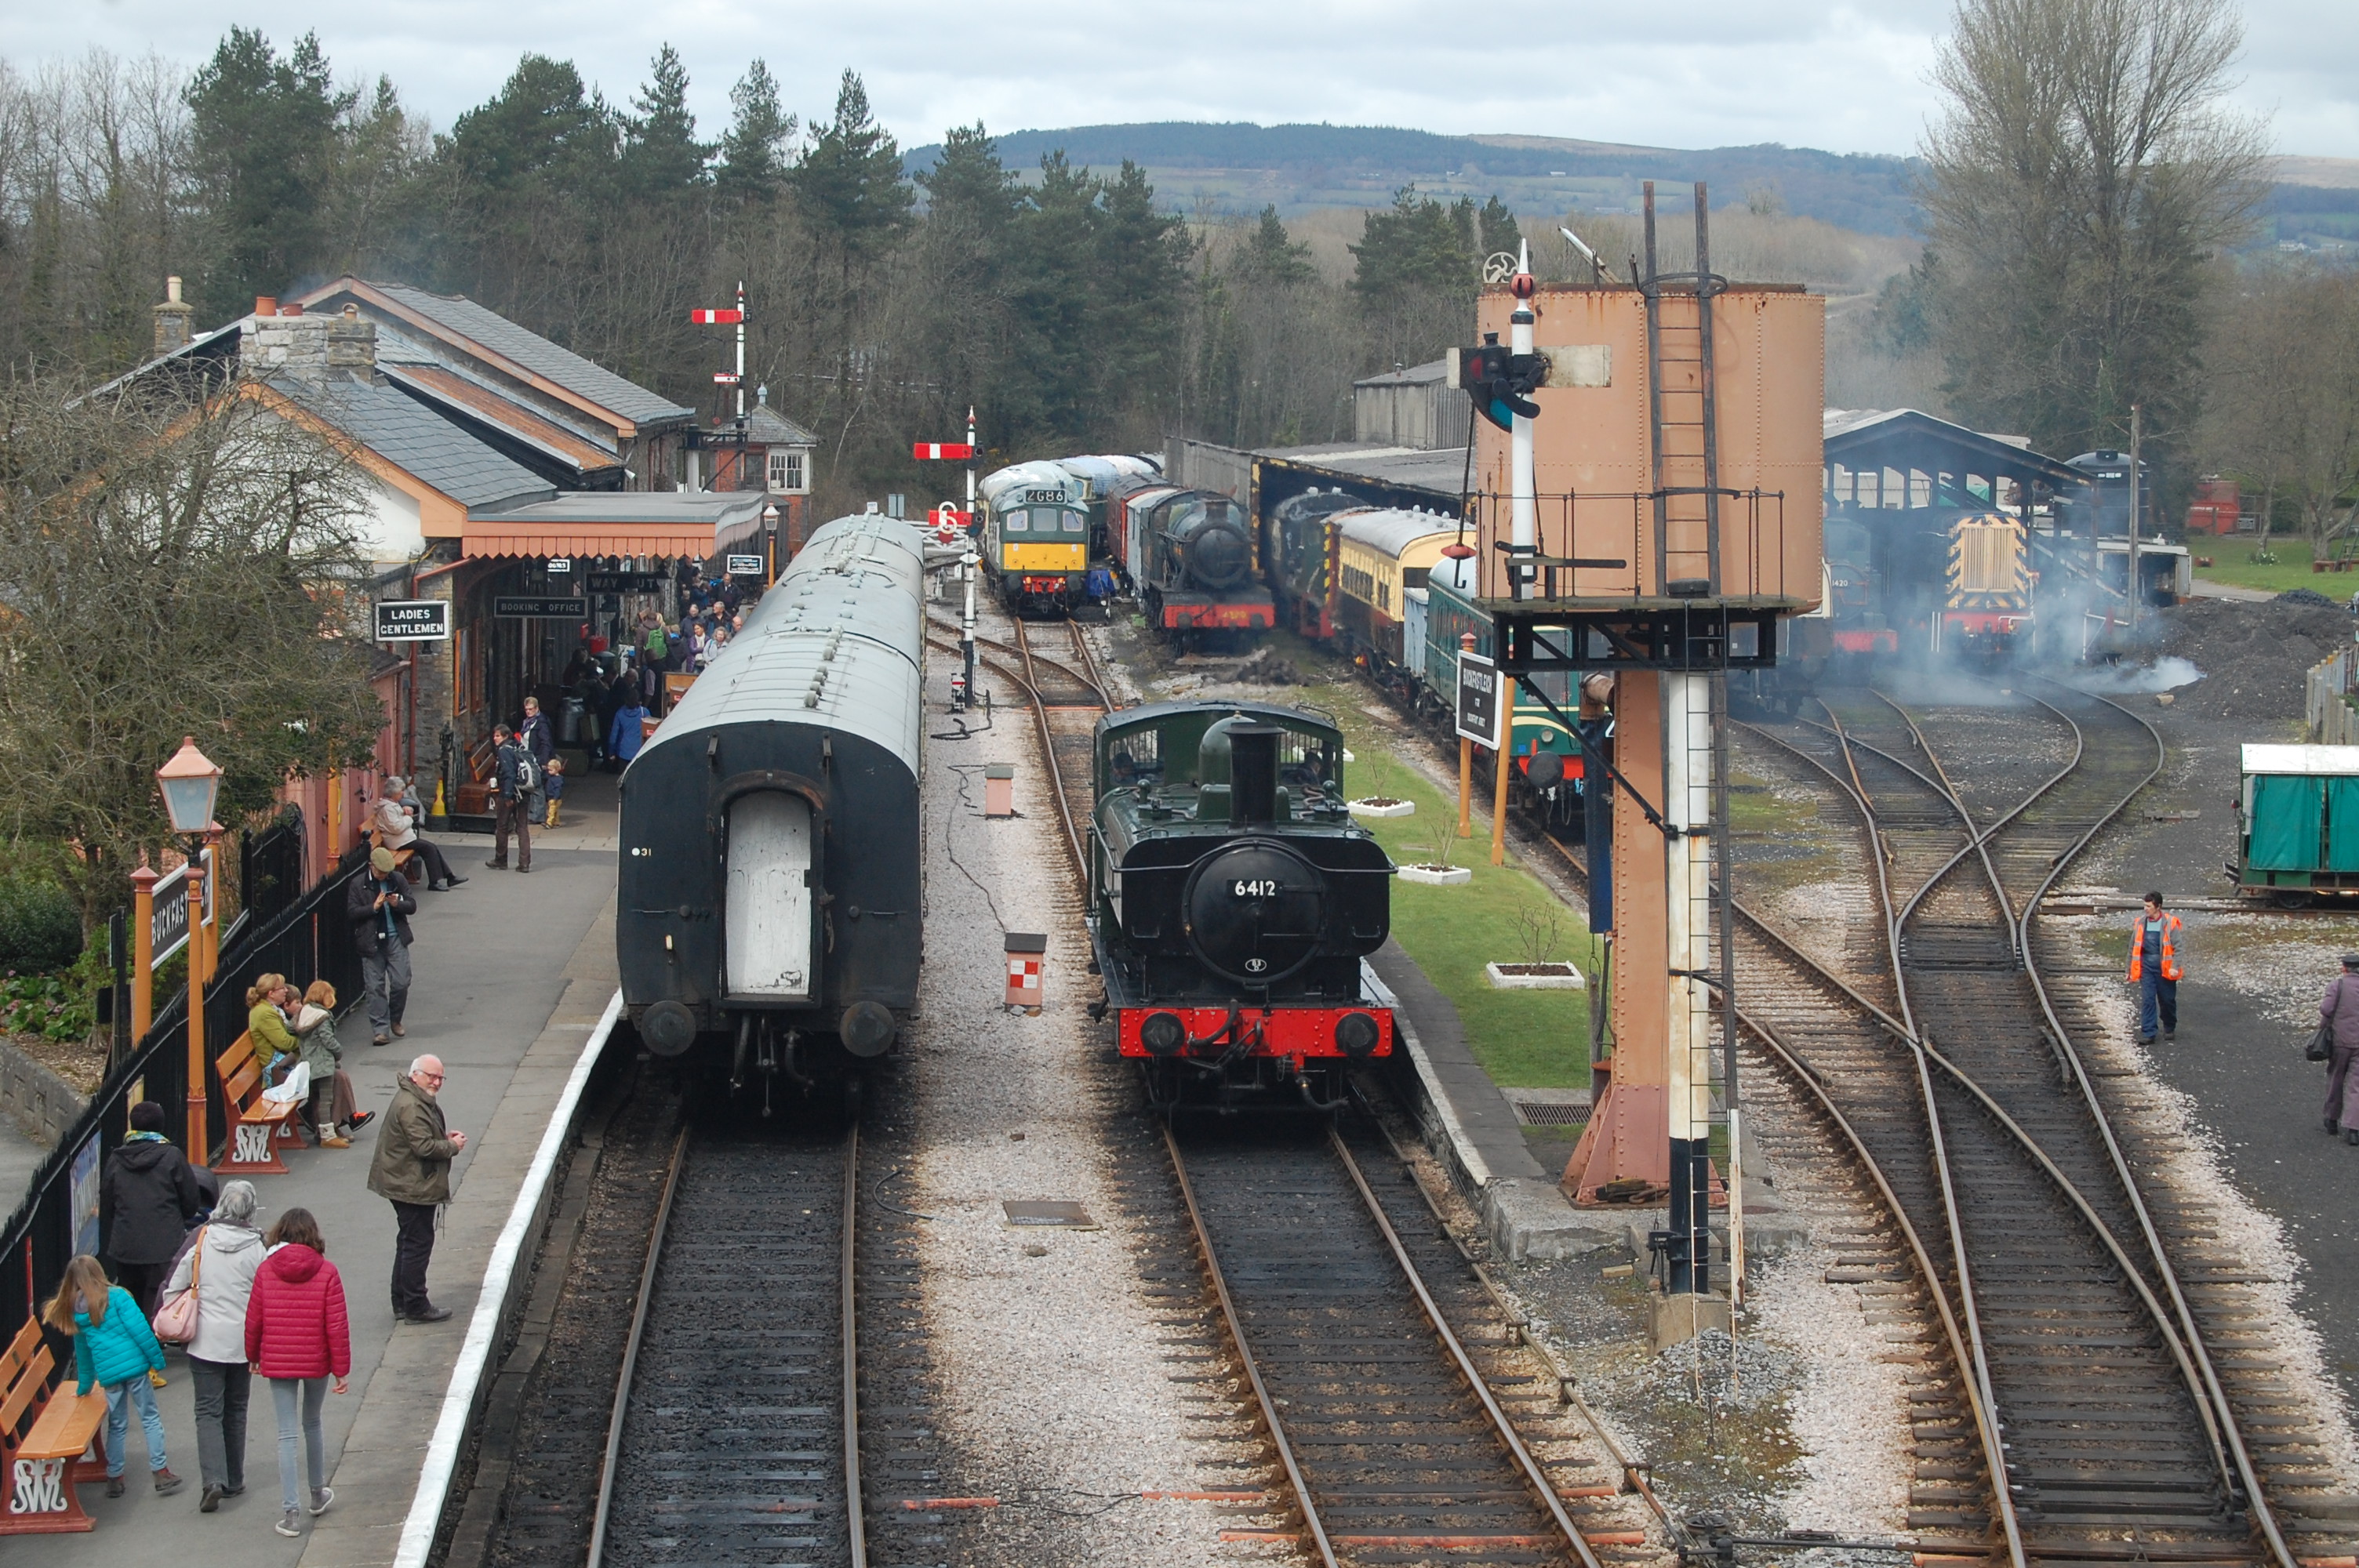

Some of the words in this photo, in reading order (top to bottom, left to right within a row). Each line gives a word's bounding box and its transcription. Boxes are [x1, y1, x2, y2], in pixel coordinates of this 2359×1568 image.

[1027, 490, 1063, 502] 2G86
[591, 578, 618, 588] WAY
[501, 602, 540, 612] BOOKING
[548, 602, 580, 612] OFFICE
[391, 609, 431, 620] LADIES
[380, 622, 444, 634] GENTLEMEN
[641, 848, 652, 856] 31
[1234, 880, 1275, 896] 6412
